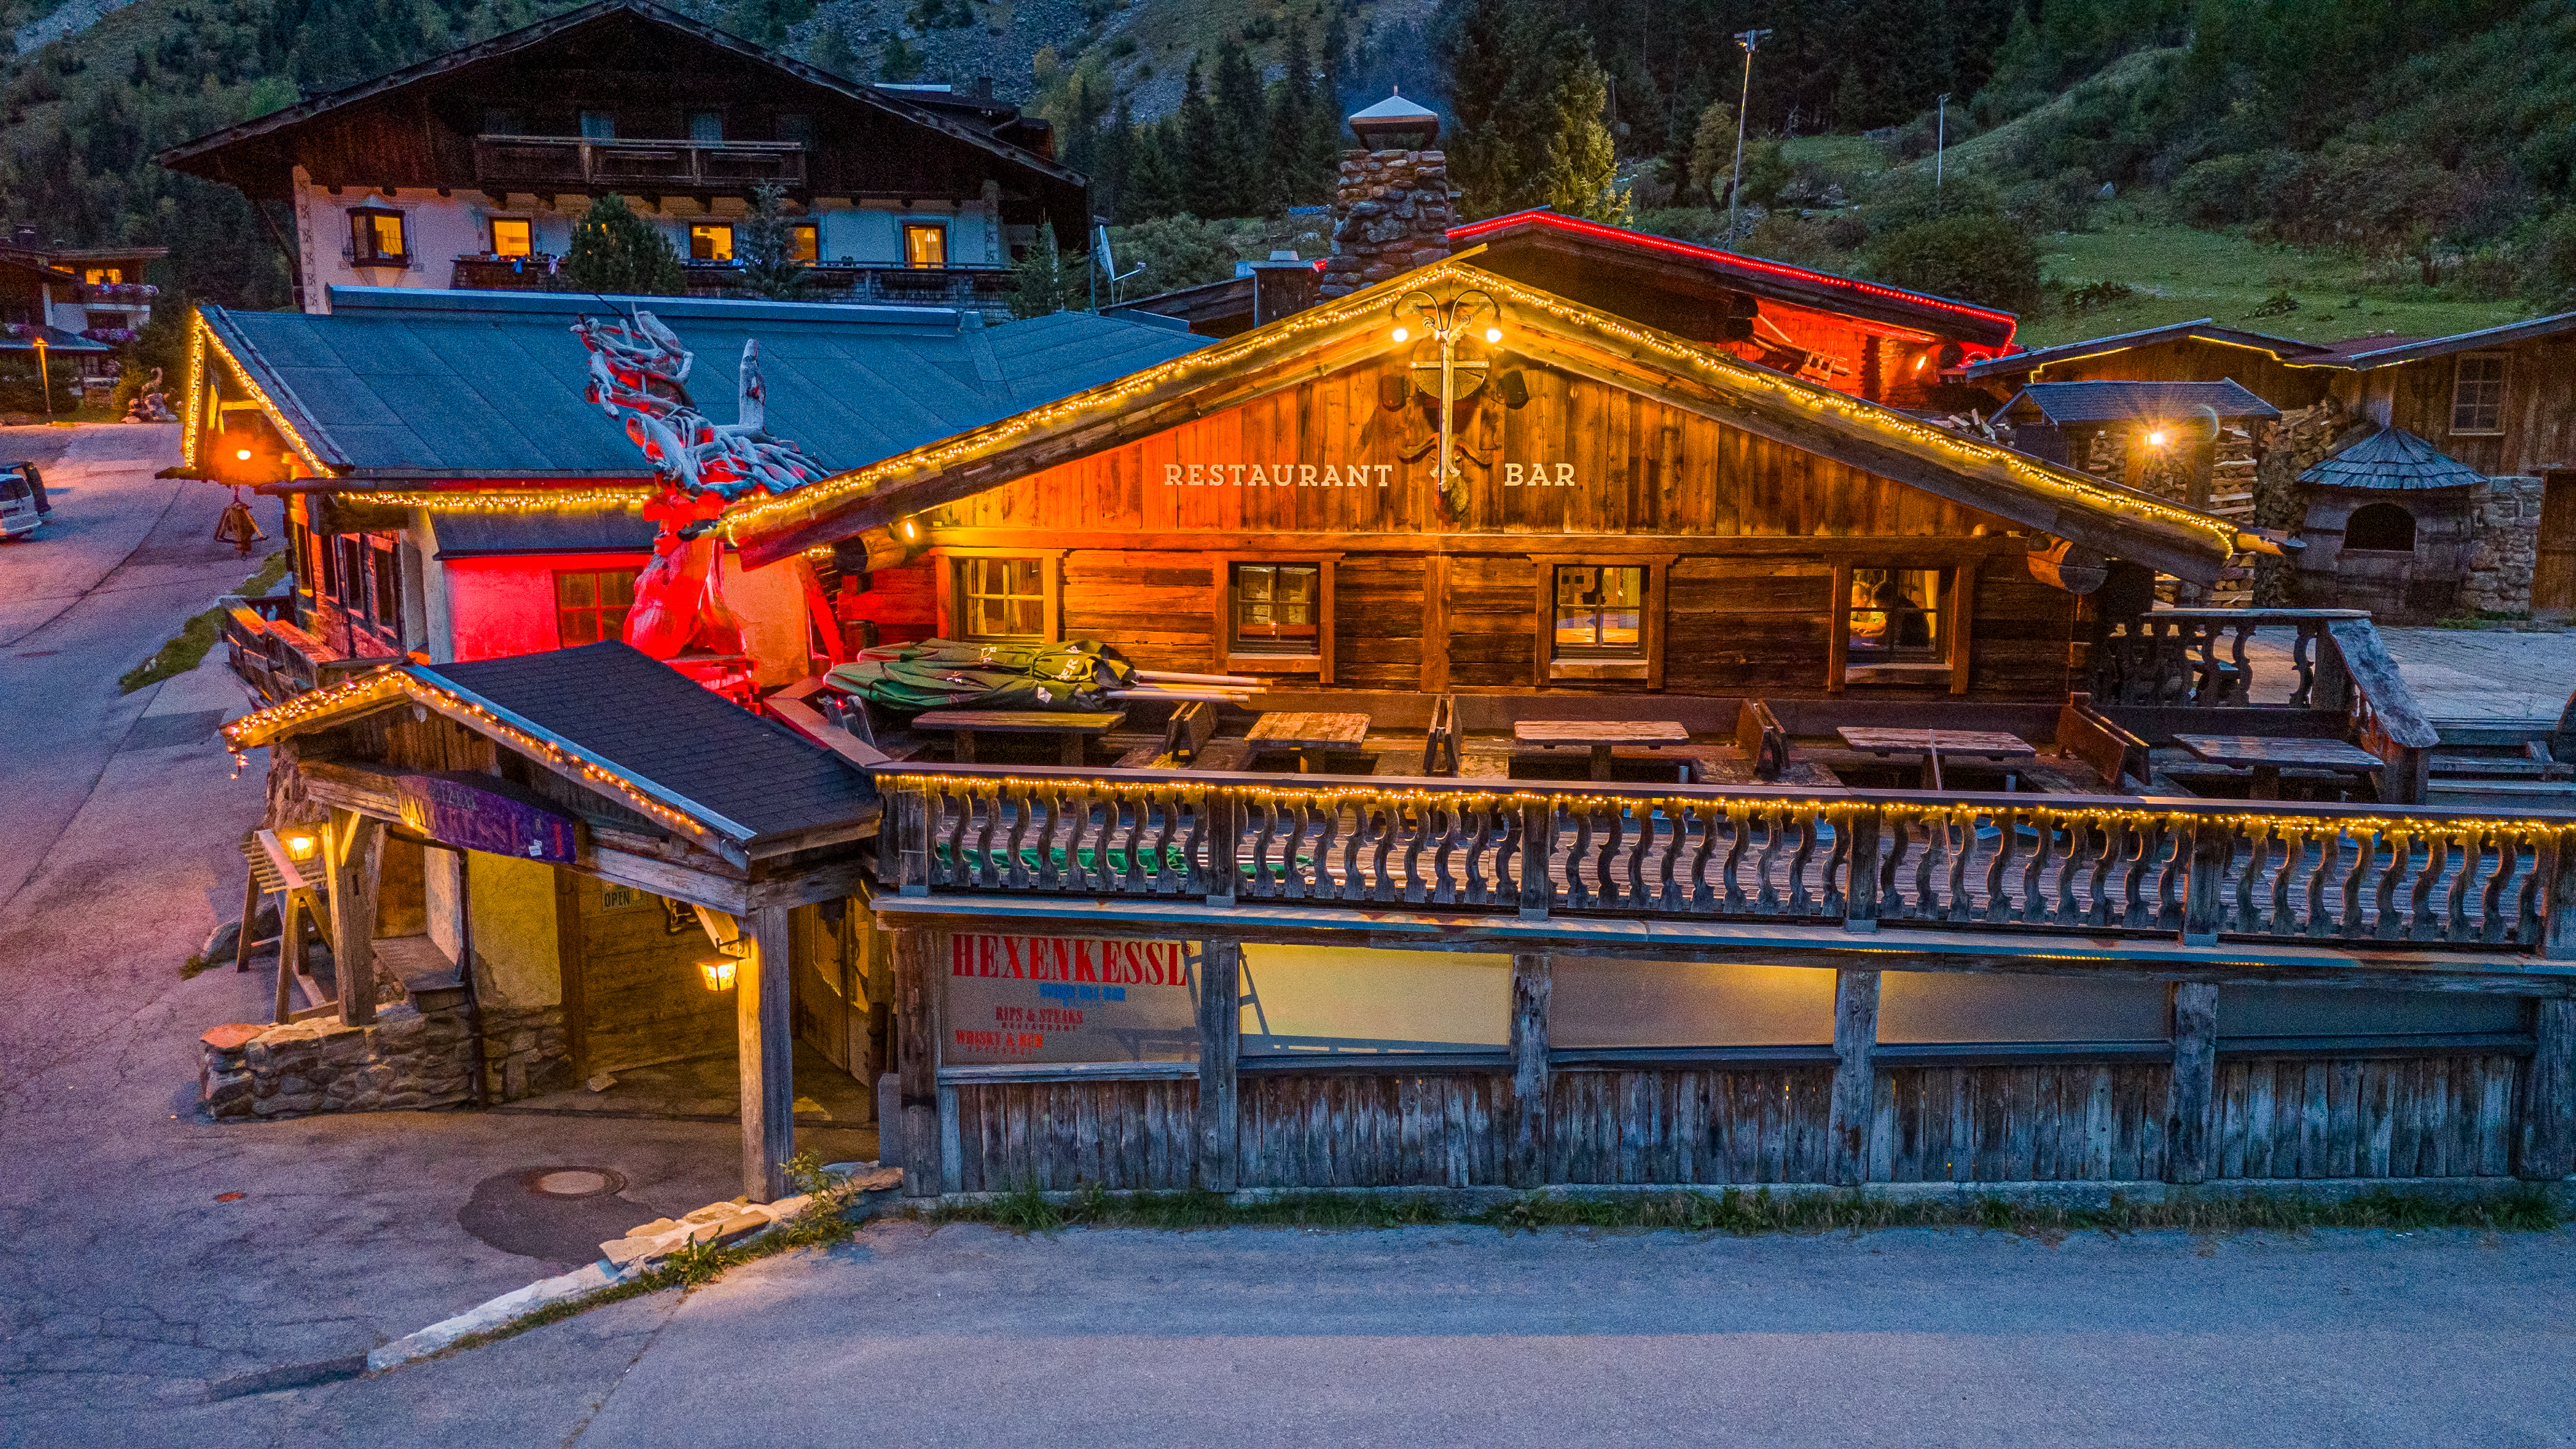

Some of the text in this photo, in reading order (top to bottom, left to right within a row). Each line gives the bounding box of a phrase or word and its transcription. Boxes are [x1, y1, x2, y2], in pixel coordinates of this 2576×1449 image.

[1164, 463, 1576, 487] RESTAURANT BAR
[604, 890, 630, 908] OPEN
[995, 1006, 1023, 1021] RIPS
[1039, 1008, 1083, 1024] STEAKS
